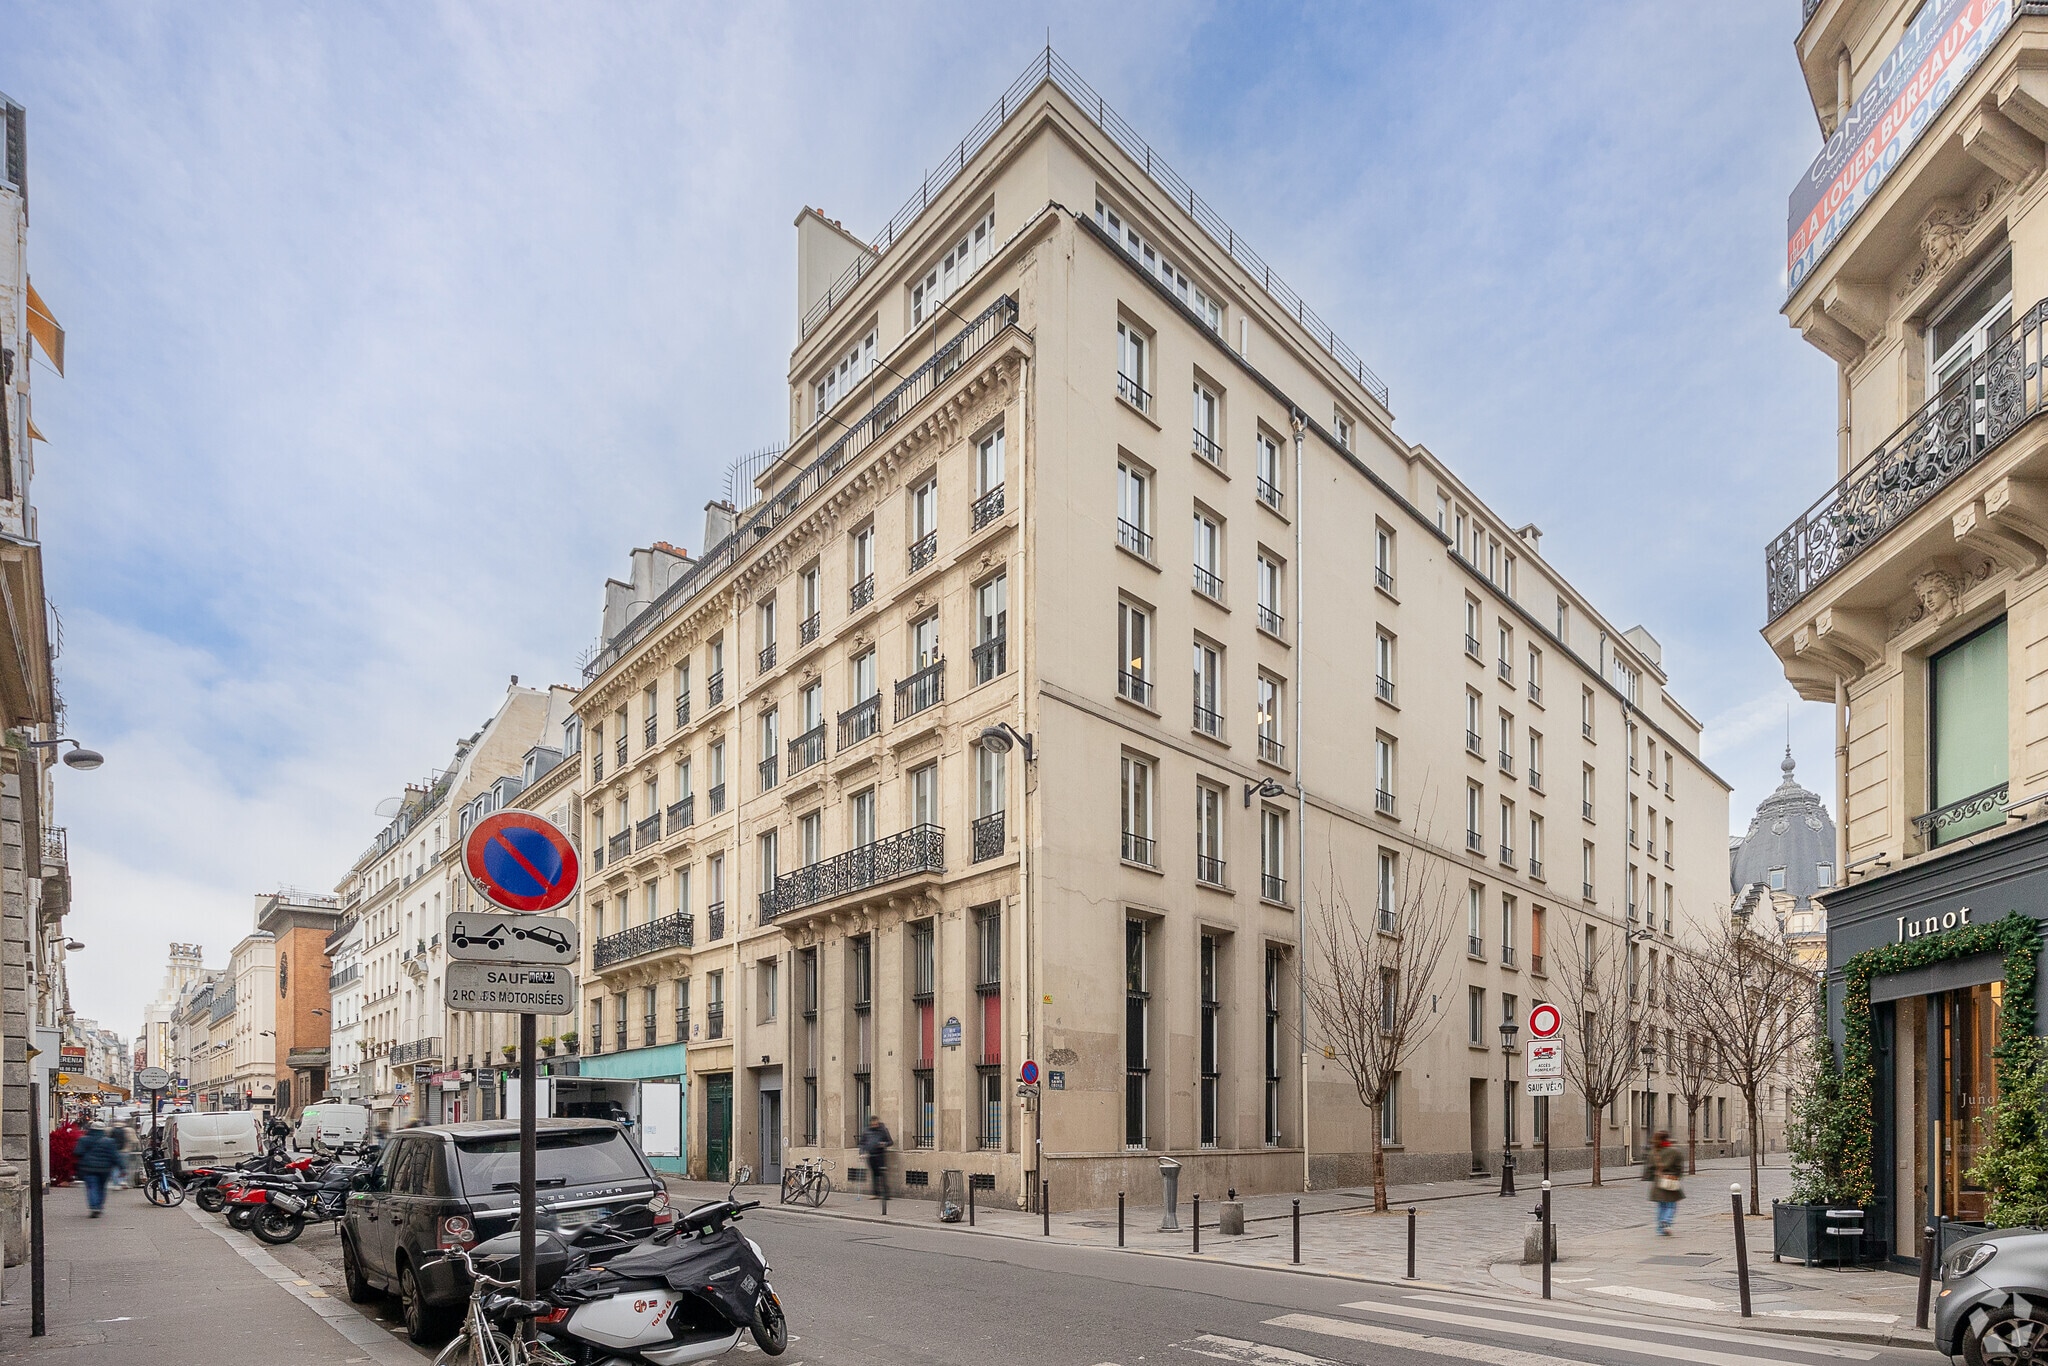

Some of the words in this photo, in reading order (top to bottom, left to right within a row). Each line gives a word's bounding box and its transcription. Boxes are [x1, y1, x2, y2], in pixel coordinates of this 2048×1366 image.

[1808, 213, 1820, 240] A
[1824, 137, 1876, 220] LOUER
[1881, 4, 1975, 147] BUREAUX
[1790, 241, 1815, 288] 01
[1822, 192, 1855, 248] 48
[1863, 136, 1900, 196] 00
[1910, 69, 1950, 138] 96
[1962, 0, 2005, 75] 32
[1815, 151, 1843, 189] CONSEIL
[1846, 132, 1856, 149] EN
[1897, 906, 1970, 943] Junot
[487, 972, 528, 985] SAUF
[452, 989, 459, 1001] 2
[461, 989, 496, 1002] ROES
[498, 990, 564, 1006] MOTORISÉES
[1528, 1084, 1543, 1092] SAUF
[575, 1187, 624, 1198] ROVER
